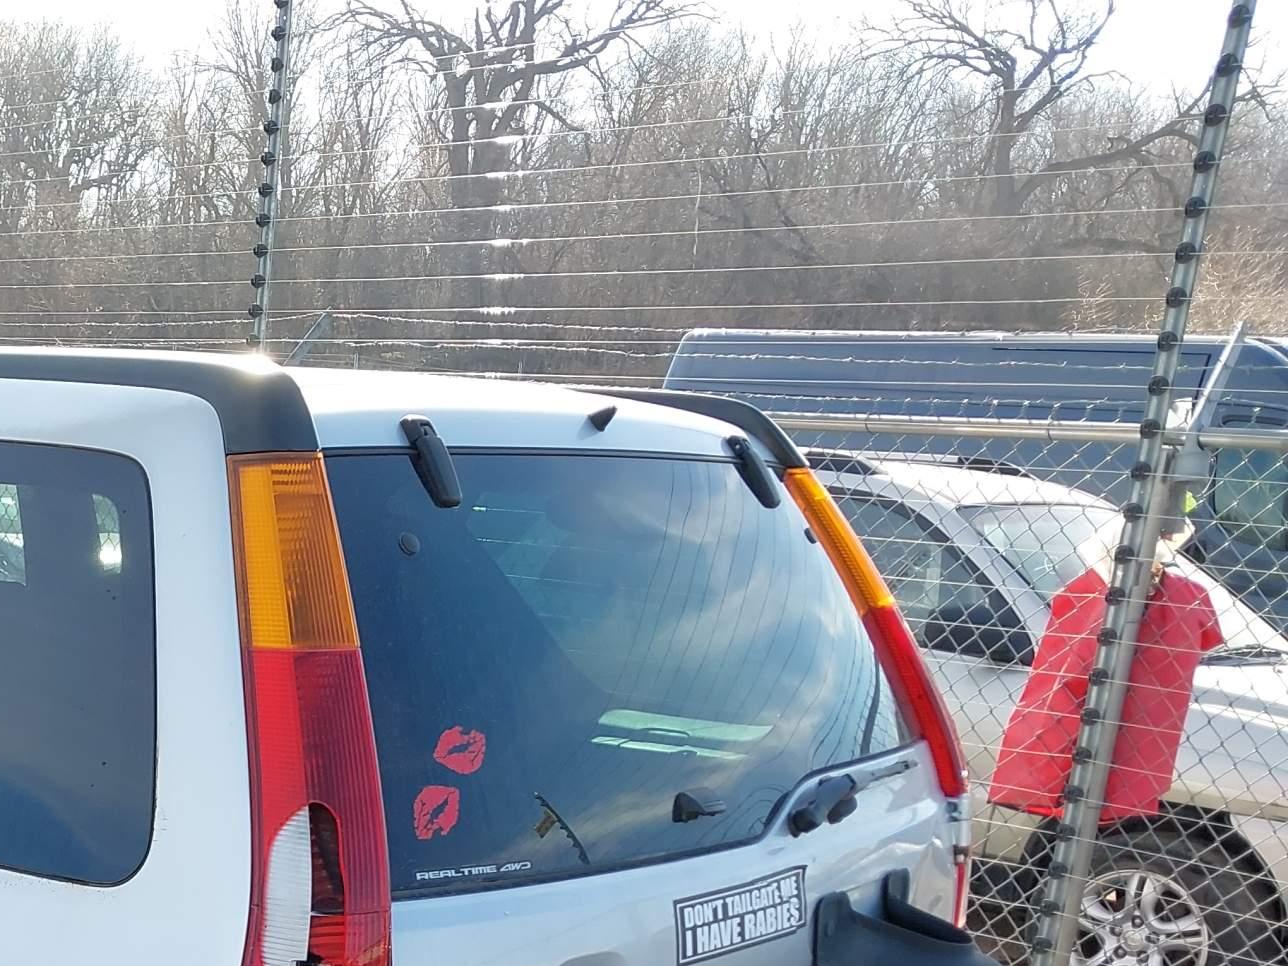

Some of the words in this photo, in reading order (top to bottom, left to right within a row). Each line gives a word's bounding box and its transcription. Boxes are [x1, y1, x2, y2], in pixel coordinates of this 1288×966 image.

[684, 899, 724, 928] DON'T
[725, 882, 781, 917] TAILGATE
[779, 876, 798, 901] ME
[685, 930, 694, 958] I
[696, 917, 742, 954] HAVE
[744, 897, 800, 940] RABIES
